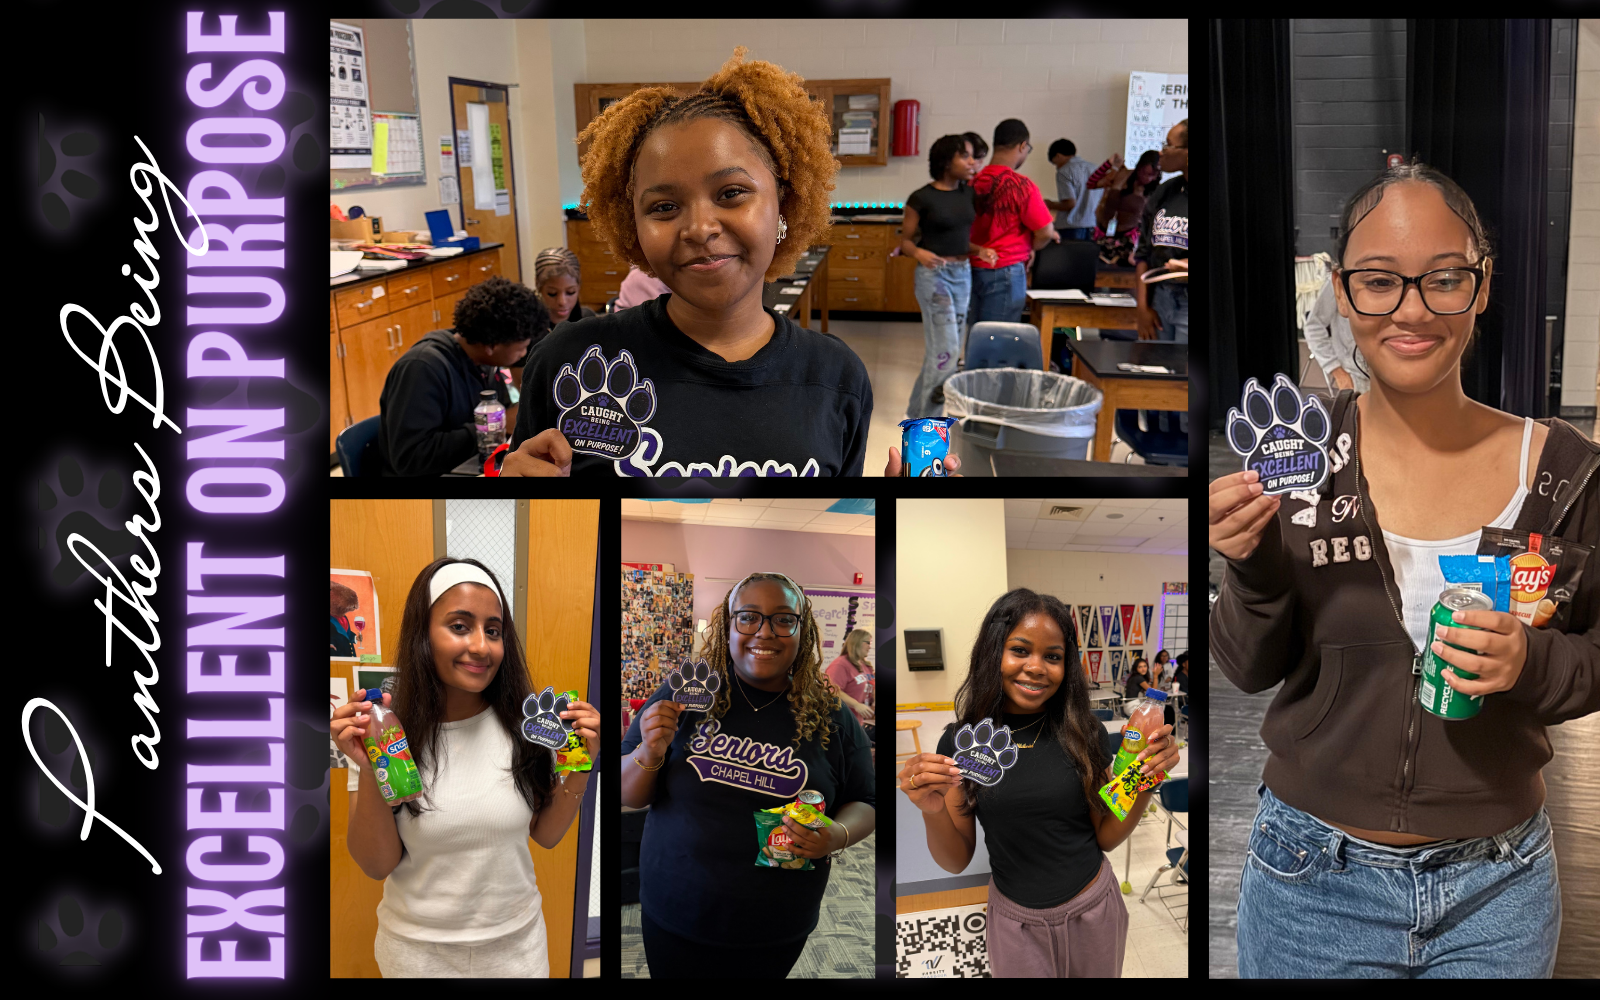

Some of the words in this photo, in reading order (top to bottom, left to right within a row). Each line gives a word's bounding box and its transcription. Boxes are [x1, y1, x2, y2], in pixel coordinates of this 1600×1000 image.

[1161, 84, 1188, 96] PERI
[581, 405, 624, 423] CAUGHT
[590, 416, 611, 426] BEING
[563, 418, 638, 445] EXCELLENT
[574, 438, 586, 448] ON
[586, 439, 625, 455] PURPOSE!
[1261, 439, 1305, 455] CAUGHT
[1274, 450, 1295, 459] BEING
[1251, 451, 1321, 478] EXCELLENT
[1267, 478, 1278, 489] ON
[1279, 471, 1315, 487] PURPOSE!
[1510, 564, 1551, 593] Lay's
[676, 694, 712, 703] EXCELLENT
[683, 686, 706, 694] CAUGHT
[1440, 679, 1451, 715] RECYCL
[525, 722, 565, 742] EXCELLENT
[536, 716, 560, 730] CAUGHT
[689, 718, 794, 773] Seniors
[957, 755, 1002, 779] EXCELLENT
[970, 750, 997, 766] CAUGHT
[710, 764, 753, 785] CHAPEL
[754, 774, 776, 790] HILL
